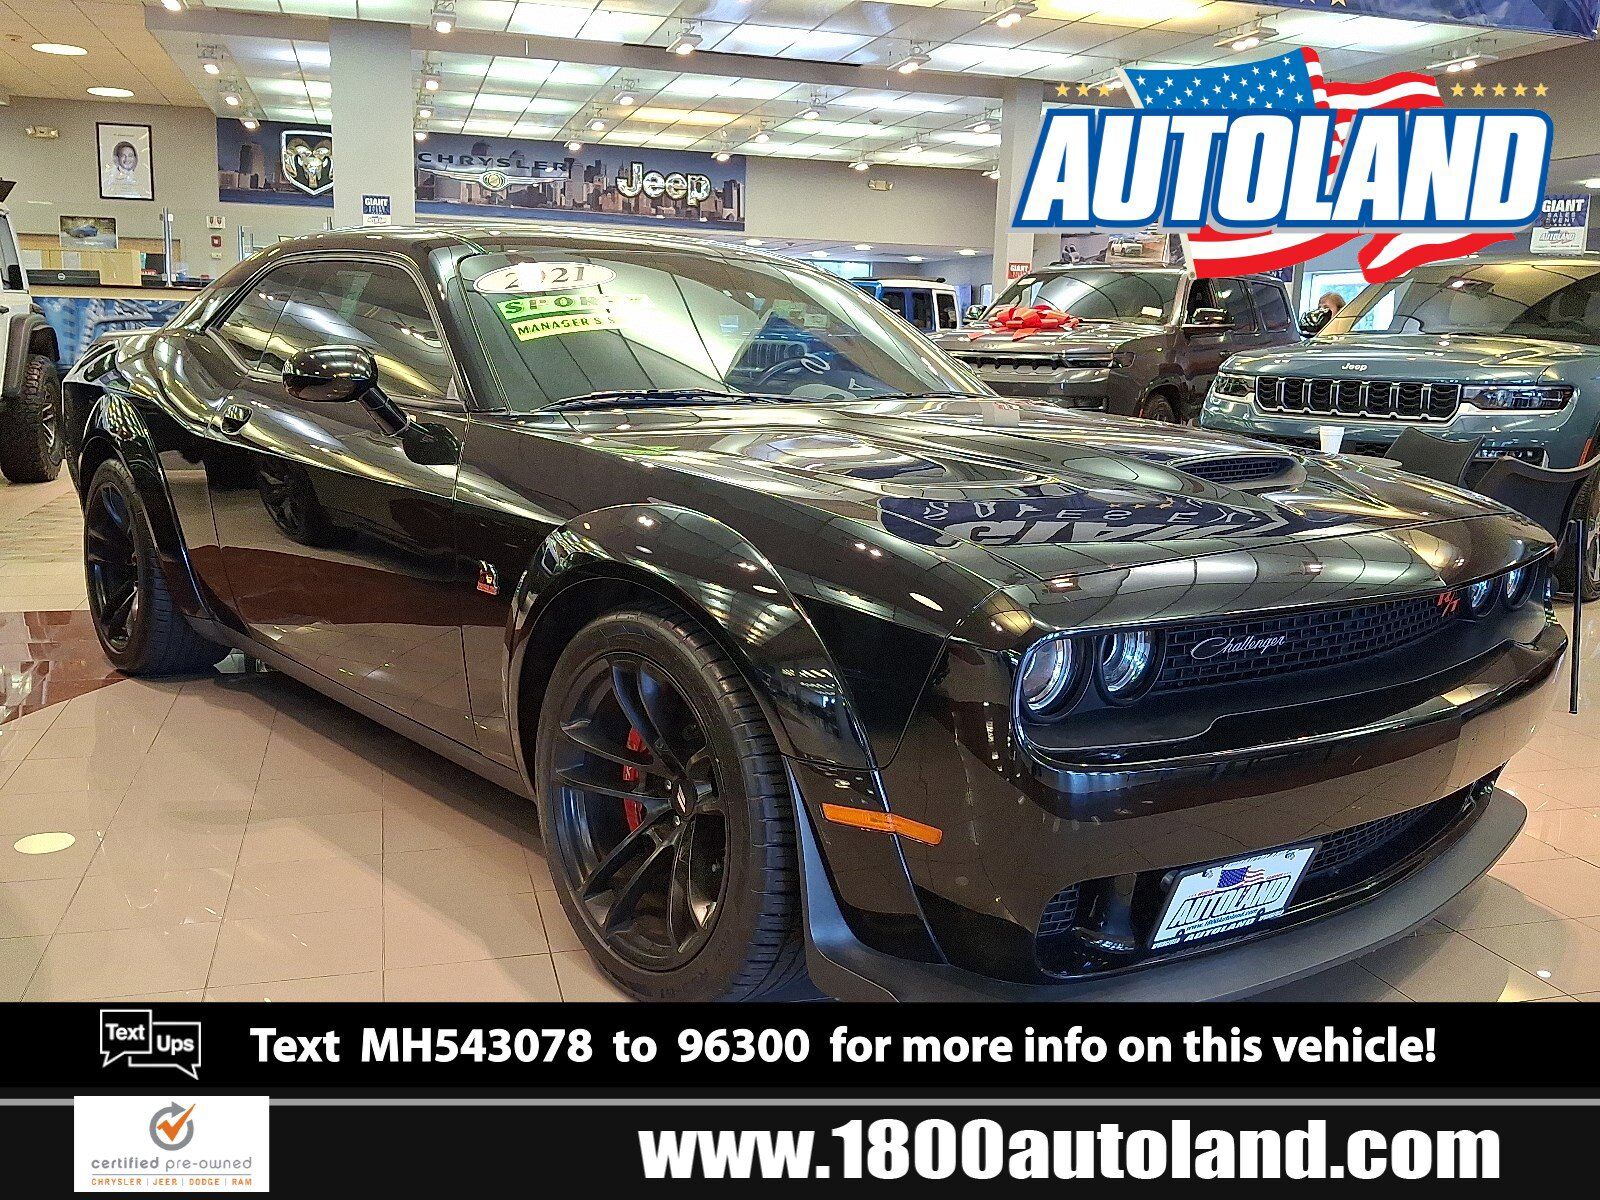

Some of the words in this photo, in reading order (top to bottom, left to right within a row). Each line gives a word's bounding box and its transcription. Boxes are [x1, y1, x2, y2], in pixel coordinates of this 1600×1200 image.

[417, 152, 568, 172] CHRYSLER
[615, 160, 712, 206] Jeep
[1542, 198, 1585, 213] GIANT
[504, 266, 586, 289] 221
[1341, 362, 1368, 372] Jeep
[1437, 591, 1461, 617] R/T
[1190, 635, 1286, 660] Challenger
[1167, 875, 1292, 929] AUTOLAND
[1184, 917, 1256, 942] AUTOLAND
